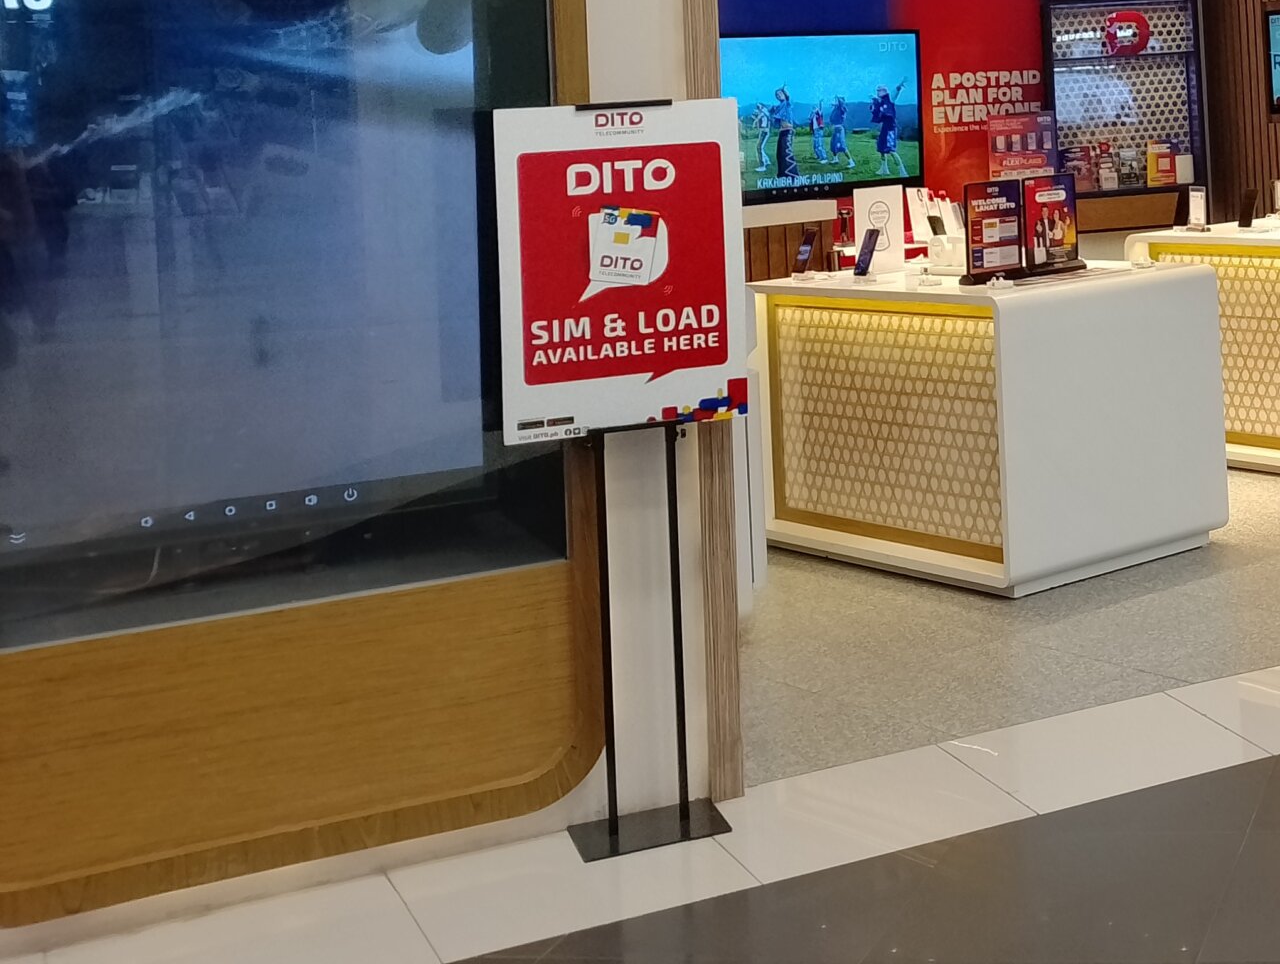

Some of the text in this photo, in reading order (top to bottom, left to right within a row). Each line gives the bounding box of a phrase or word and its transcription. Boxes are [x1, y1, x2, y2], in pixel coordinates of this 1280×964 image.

[879, 41, 907, 53] DITO
[931, 70, 1041, 89] A POSTPAID
[932, 86, 1023, 105] PLAN FOR
[594, 111, 644, 128] DITO
[932, 101, 1041, 124] EVERYONE
[933, 125, 968, 133] Experience
[566, 158, 676, 196] DITO
[794, 174, 810, 186] ANG
[971, 197, 1007, 207] WELCOME
[999, 202, 1016, 210] DITO
[603, 213, 617, 225] 5G
[600, 254, 643, 271] DITO
[530, 304, 721, 345] SIM & LOAD
[531, 332, 720, 366] AVAILABLE HERE
